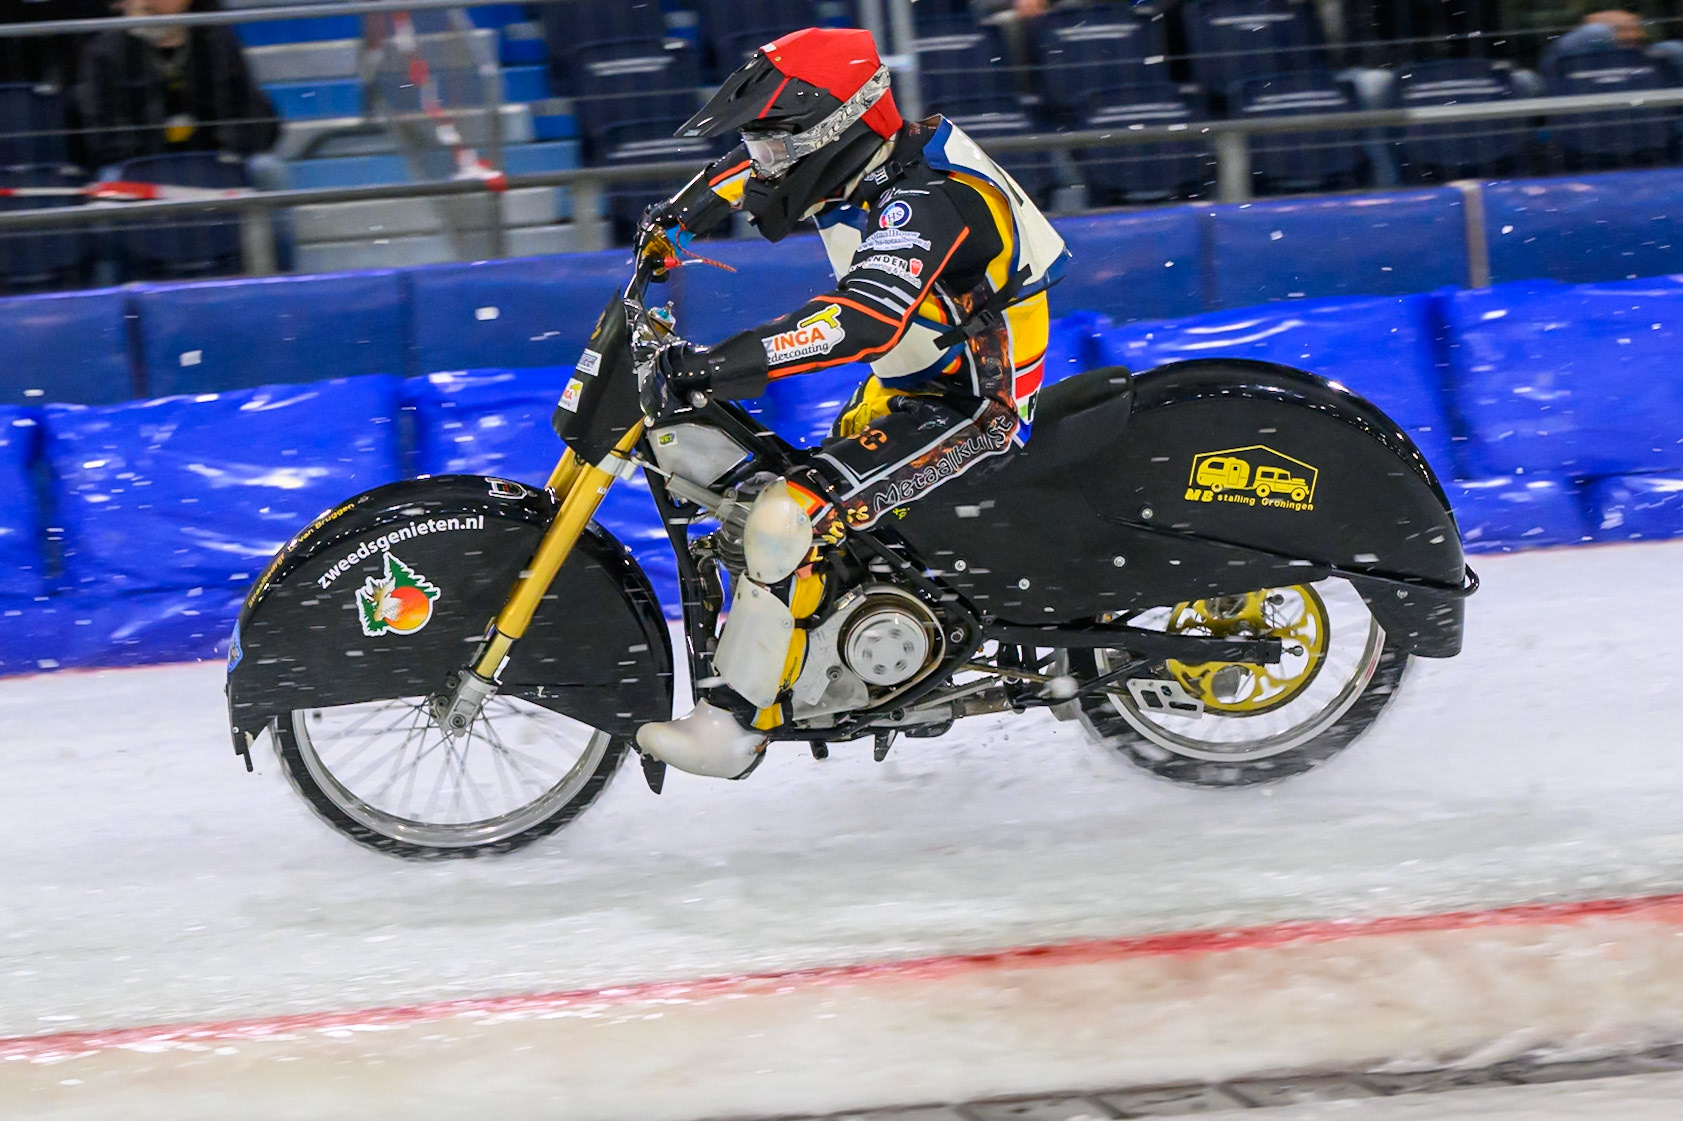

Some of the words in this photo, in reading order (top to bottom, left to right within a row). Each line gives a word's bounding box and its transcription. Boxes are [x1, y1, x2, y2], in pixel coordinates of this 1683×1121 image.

[888, 210, 902, 222] HS
[1217, 493, 1256, 506] stalling
[1261, 497, 1314, 511] Groningen
[298, 528, 314, 543] van
[315, 503, 354, 529] Bruggen
[317, 515, 484, 589] zweedsgenieten.nl
